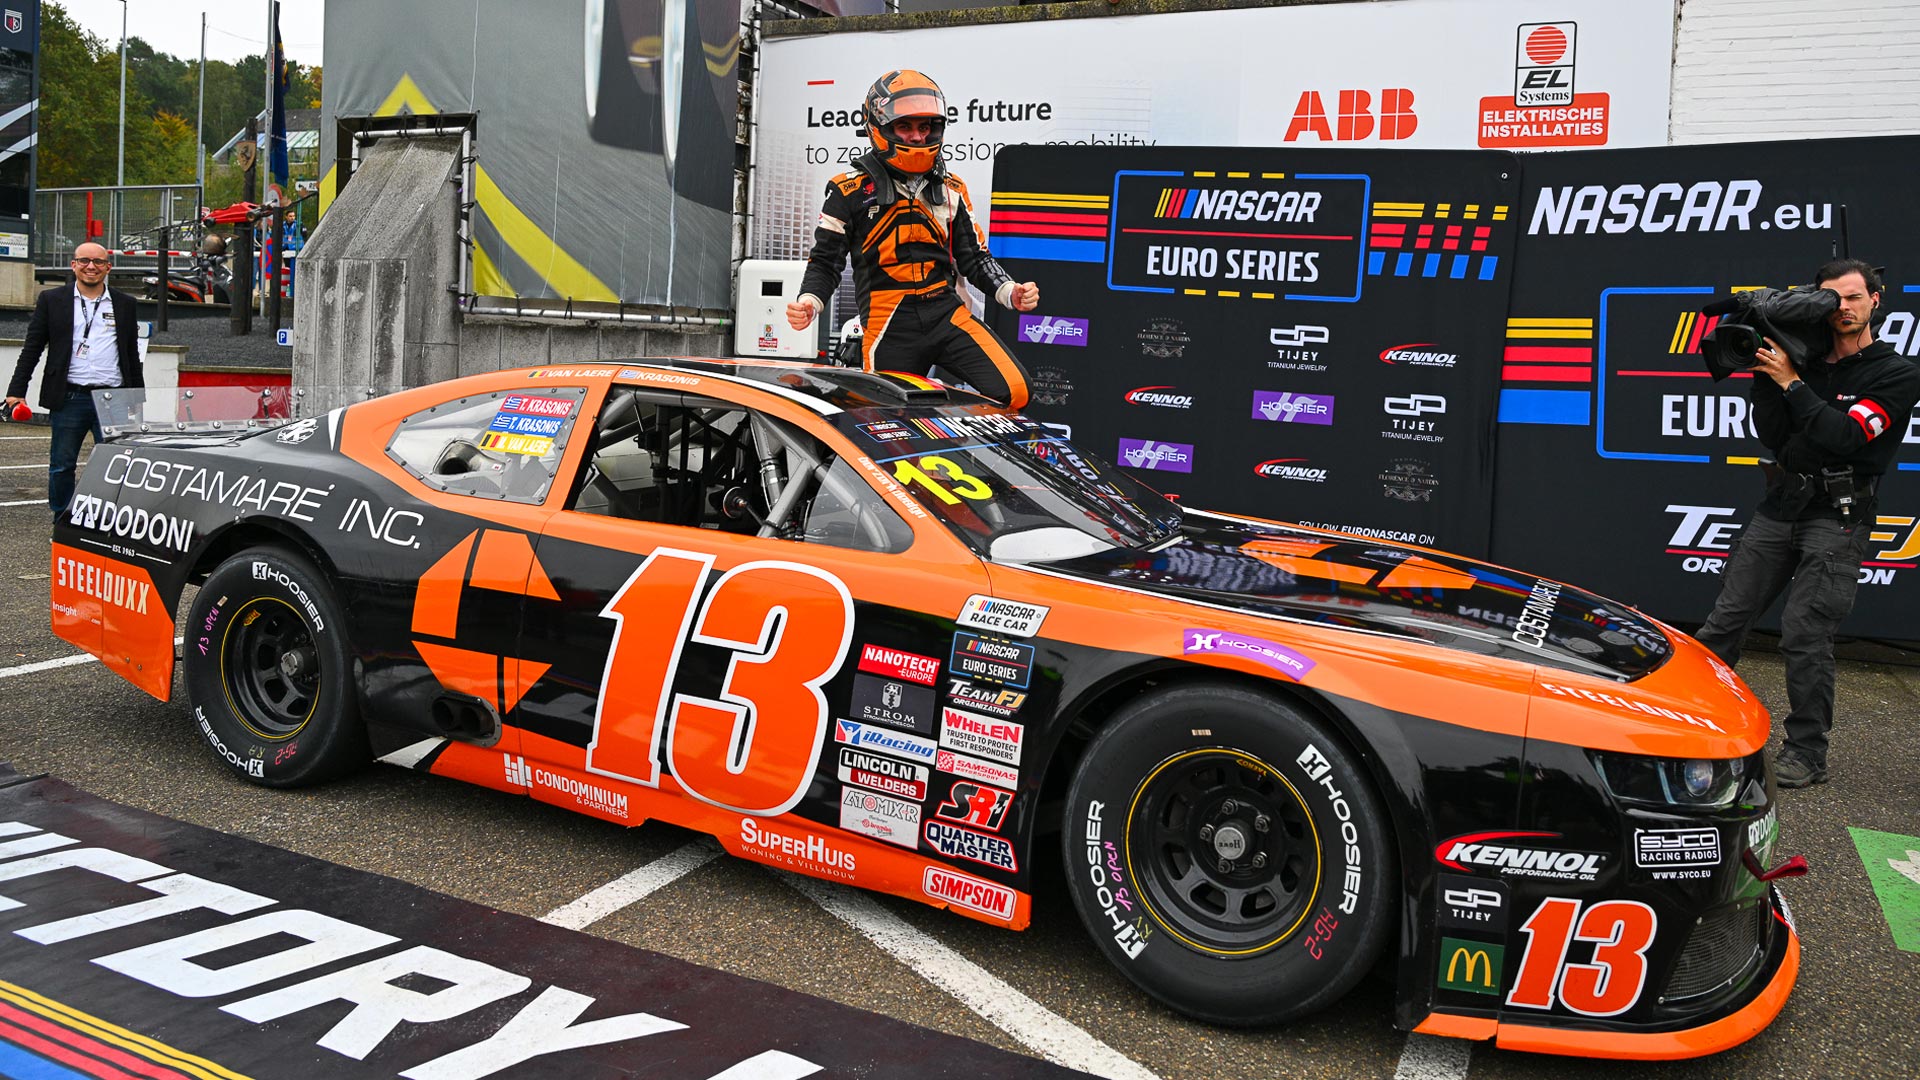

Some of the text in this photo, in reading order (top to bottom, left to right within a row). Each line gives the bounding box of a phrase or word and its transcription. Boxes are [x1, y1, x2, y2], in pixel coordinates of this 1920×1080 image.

[1521, 69, 1569, 89] EL
[1519, 91, 1570, 104] Systems
[807, 105, 866, 128] Lead
[967, 98, 1053, 123] future
[1283, 88, 1418, 142] ABB
[1483, 107, 1605, 123] ELEKTRISCHE
[1481, 122, 1604, 138] INSTALLATIES
[806, 143, 829, 164] to
[836, 146, 871, 164] zer
[1192, 189, 1323, 223] NASCAR
[1146, 245, 1321, 283] EURO SERIES
[1025, 323, 1084, 337] HOOSIER
[1267, 361, 1328, 372] TITANIUM JEWELRY
[1277, 350, 1319, 361] TIJEY
[1384, 350, 1458, 365] KENNOL
[548, 368, 615, 378] VAN LAERE
[636, 372, 701, 386] KRASONIS
[526, 399, 571, 416] KRASONIS
[1129, 391, 1193, 407] KENNOL
[1260, 400, 1328, 416] HOOSIER
[516, 417, 561, 434] KRASONIS
[1392, 419, 1435, 432] TIJEY
[1381, 431, 1444, 443] TITANIUM JEWELRY
[1125, 447, 1188, 463] HOOSIER
[893, 455, 994, 505] 13
[1259, 464, 1328, 480] KENNOL
[100, 501, 195, 554] DODONI
[338, 498, 425, 549] INC.
[1664, 504, 1743, 550] TE
[1341, 525, 1417, 544] EURONASCAR
[1418, 533, 1436, 546] ON
[58, 556, 150, 616] STEELDUXX
[266, 567, 325, 633] HOOSIER
[970, 612, 1029, 632] RACE CAR
[989, 602, 1036, 621] NASCAR
[864, 647, 938, 675] NANOTECH
[979, 641, 1021, 661] NASCAR
[1218, 638, 1304, 671] HOOSIER
[962, 658, 1018, 681] EURO SERIES
[585, 546, 856, 817] 13
[863, 705, 916, 725] STROM
[953, 697, 1012, 716] ORGANIZATION
[1541, 683, 1727, 735] STEELDUXX
[945, 709, 1020, 744] WHELEN
[195, 706, 249, 773] HOOSIER
[863, 730, 935, 758] iRacing
[947, 728, 1018, 753] TRUSTED TO PROTECT
[949, 738, 1013, 760] FIRST RESPONDERS
[844, 751, 913, 781] LINCOLN
[956, 759, 1017, 781] SAMSONAS
[535, 768, 628, 812] CONDOMINIUM
[857, 771, 918, 797] WELDERS
[576, 795, 629, 820] & PARTNERS
[926, 822, 1010, 856] QUARTER
[1318, 775, 1362, 915] HOOSIER
[741, 844, 856, 881] WONING & VILLABOUW
[940, 838, 1014, 869] MASTER
[1444, 842, 1602, 874] KENNOL
[1640, 850, 1718, 862] RACING RADIOS
[1086, 799, 1127, 931] HOOSIER
[1500, 867, 1596, 881] PERFORMANCE OIL
[1651, 870, 1711, 880] WWW.SYCO.EU
[929, 873, 1009, 914] SIMPSON
[1451, 908, 1492, 922] TIJEY
[1505, 897, 1658, 1017] 13
